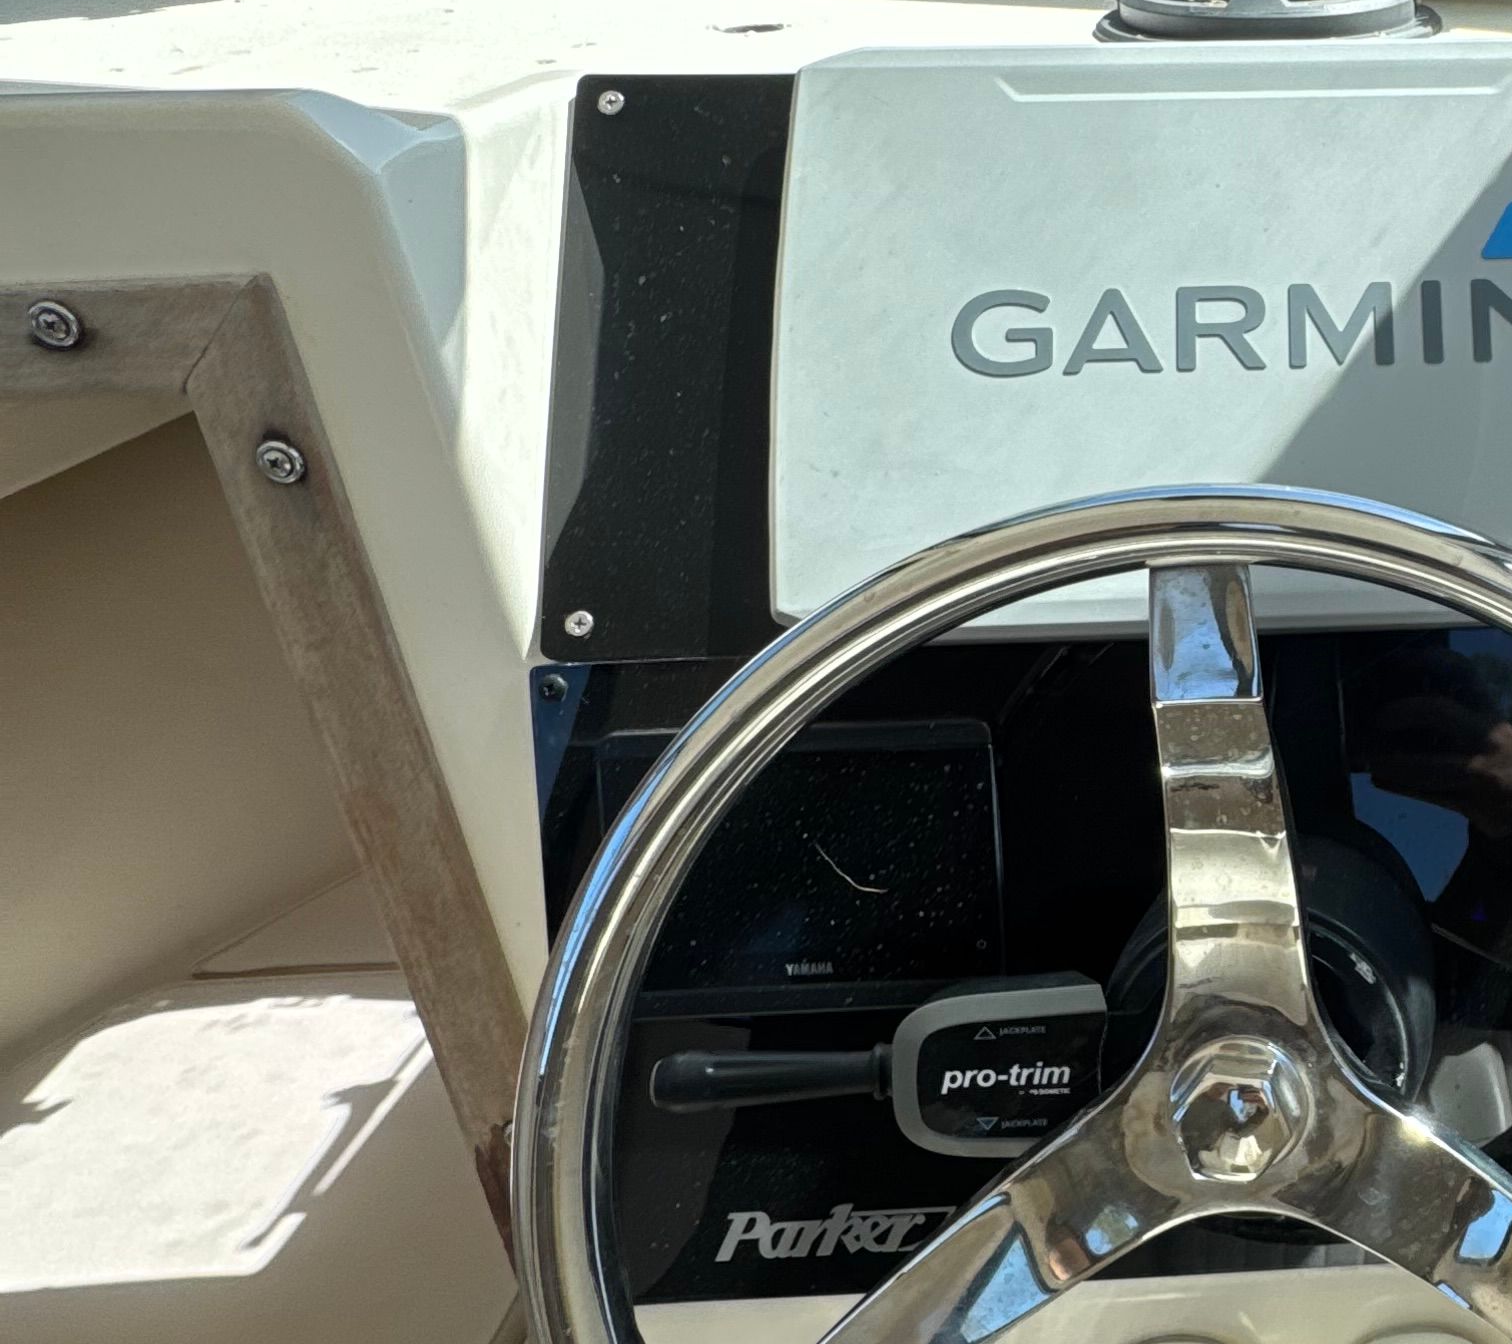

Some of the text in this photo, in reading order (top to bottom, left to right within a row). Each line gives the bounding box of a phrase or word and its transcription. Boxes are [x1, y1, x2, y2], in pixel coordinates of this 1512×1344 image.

[785, 961, 834, 976] YAMAHA
[941, 1061, 1071, 1095] pro-trim
[714, 1203, 957, 1262] Parker
